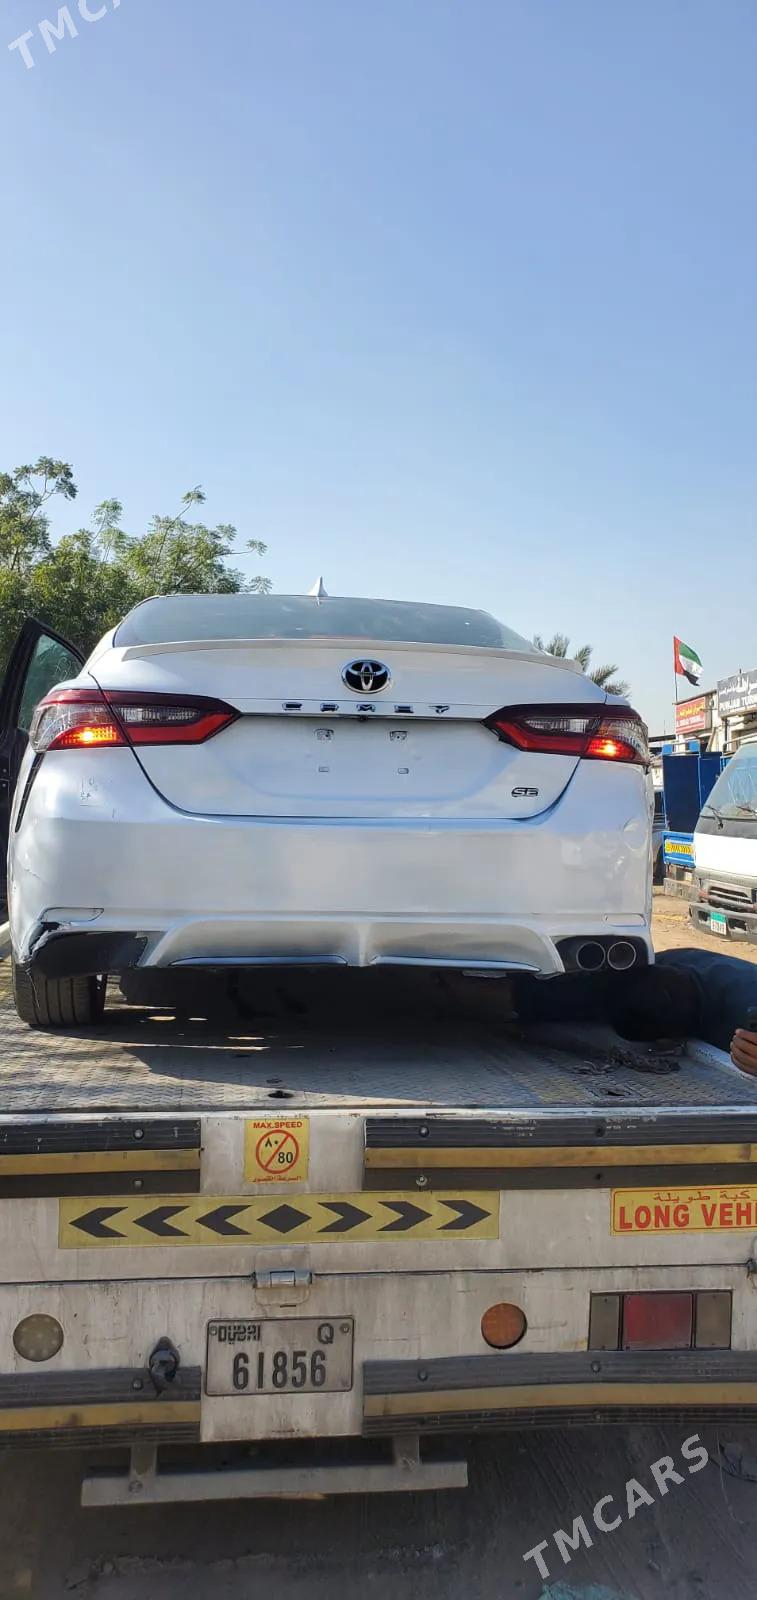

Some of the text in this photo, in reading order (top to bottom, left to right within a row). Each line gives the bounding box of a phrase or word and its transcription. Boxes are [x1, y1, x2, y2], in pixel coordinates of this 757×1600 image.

[511, 787, 539, 797] SE
[278, 1151, 294, 1164] 80
[653, 1191, 711, 1203] طويلة
[619, 1204, 690, 1230] LONG
[217, 1323, 335, 1344] DUBAI Q
[232, 1350, 327, 1390] 61856
